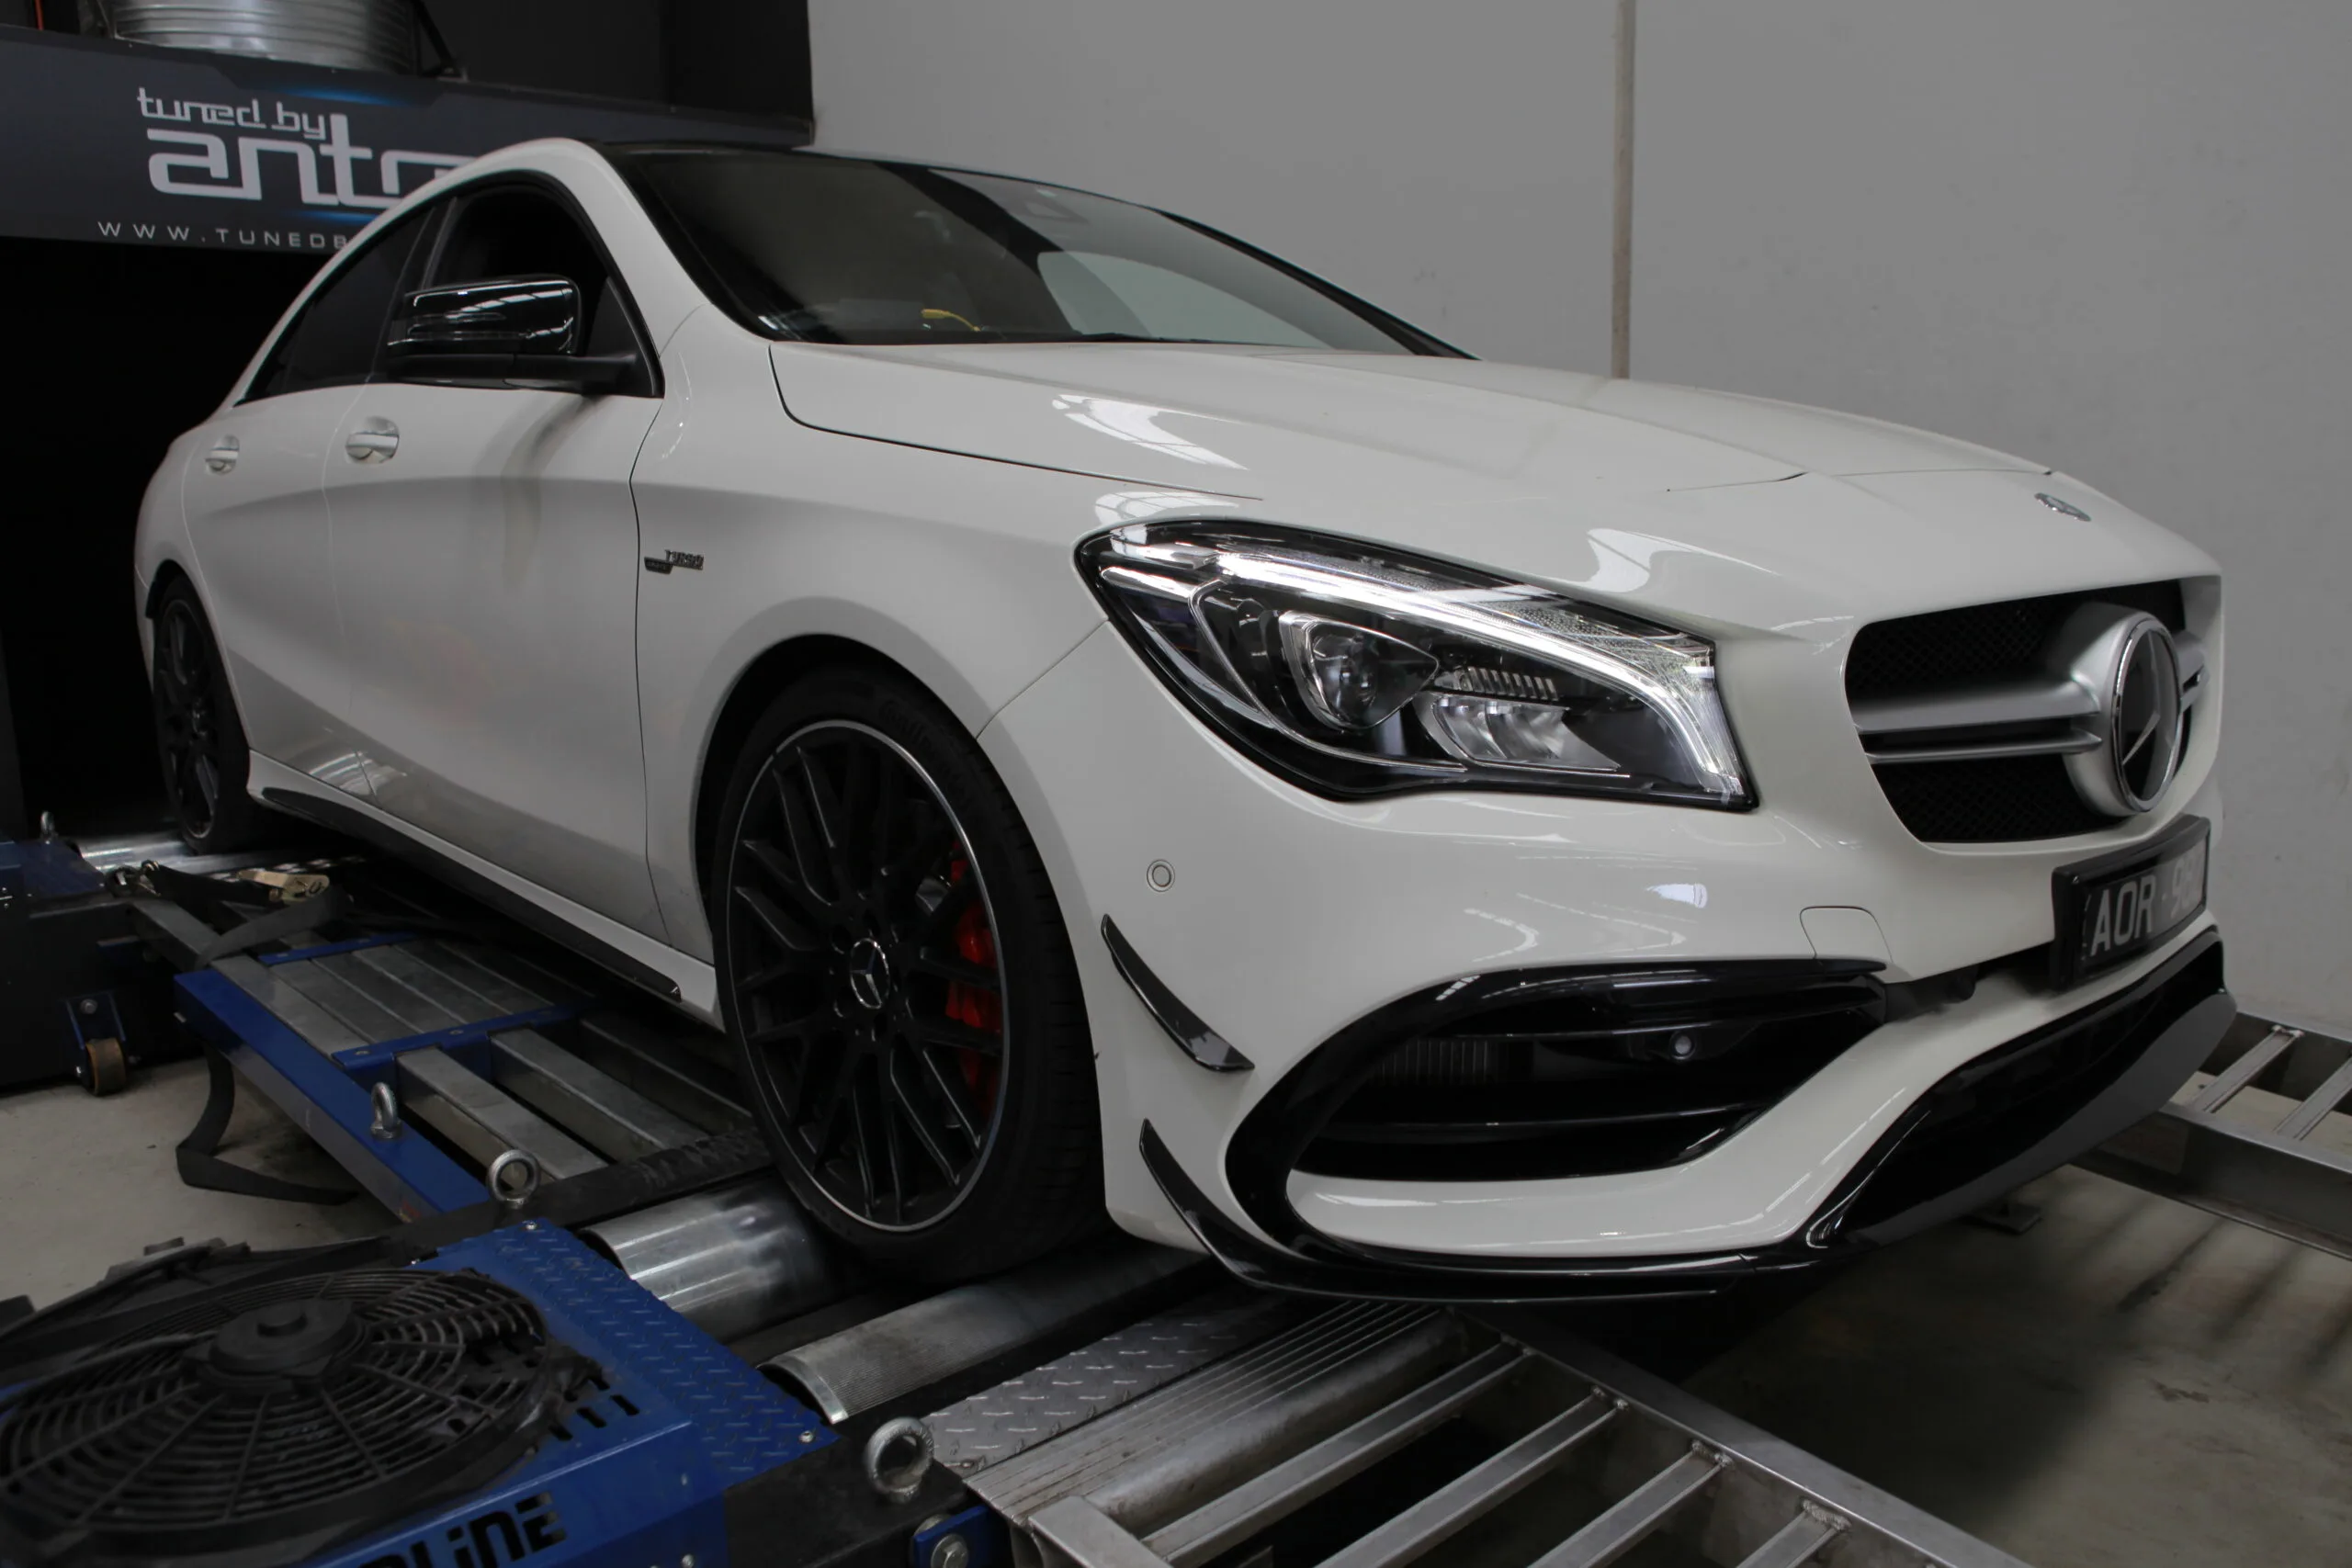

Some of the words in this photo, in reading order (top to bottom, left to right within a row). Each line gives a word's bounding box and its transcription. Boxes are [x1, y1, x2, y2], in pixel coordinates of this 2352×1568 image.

[137, 87, 266, 129] tuned
[271, 101, 327, 141] by
[2090, 874, 2156, 957] AOR
